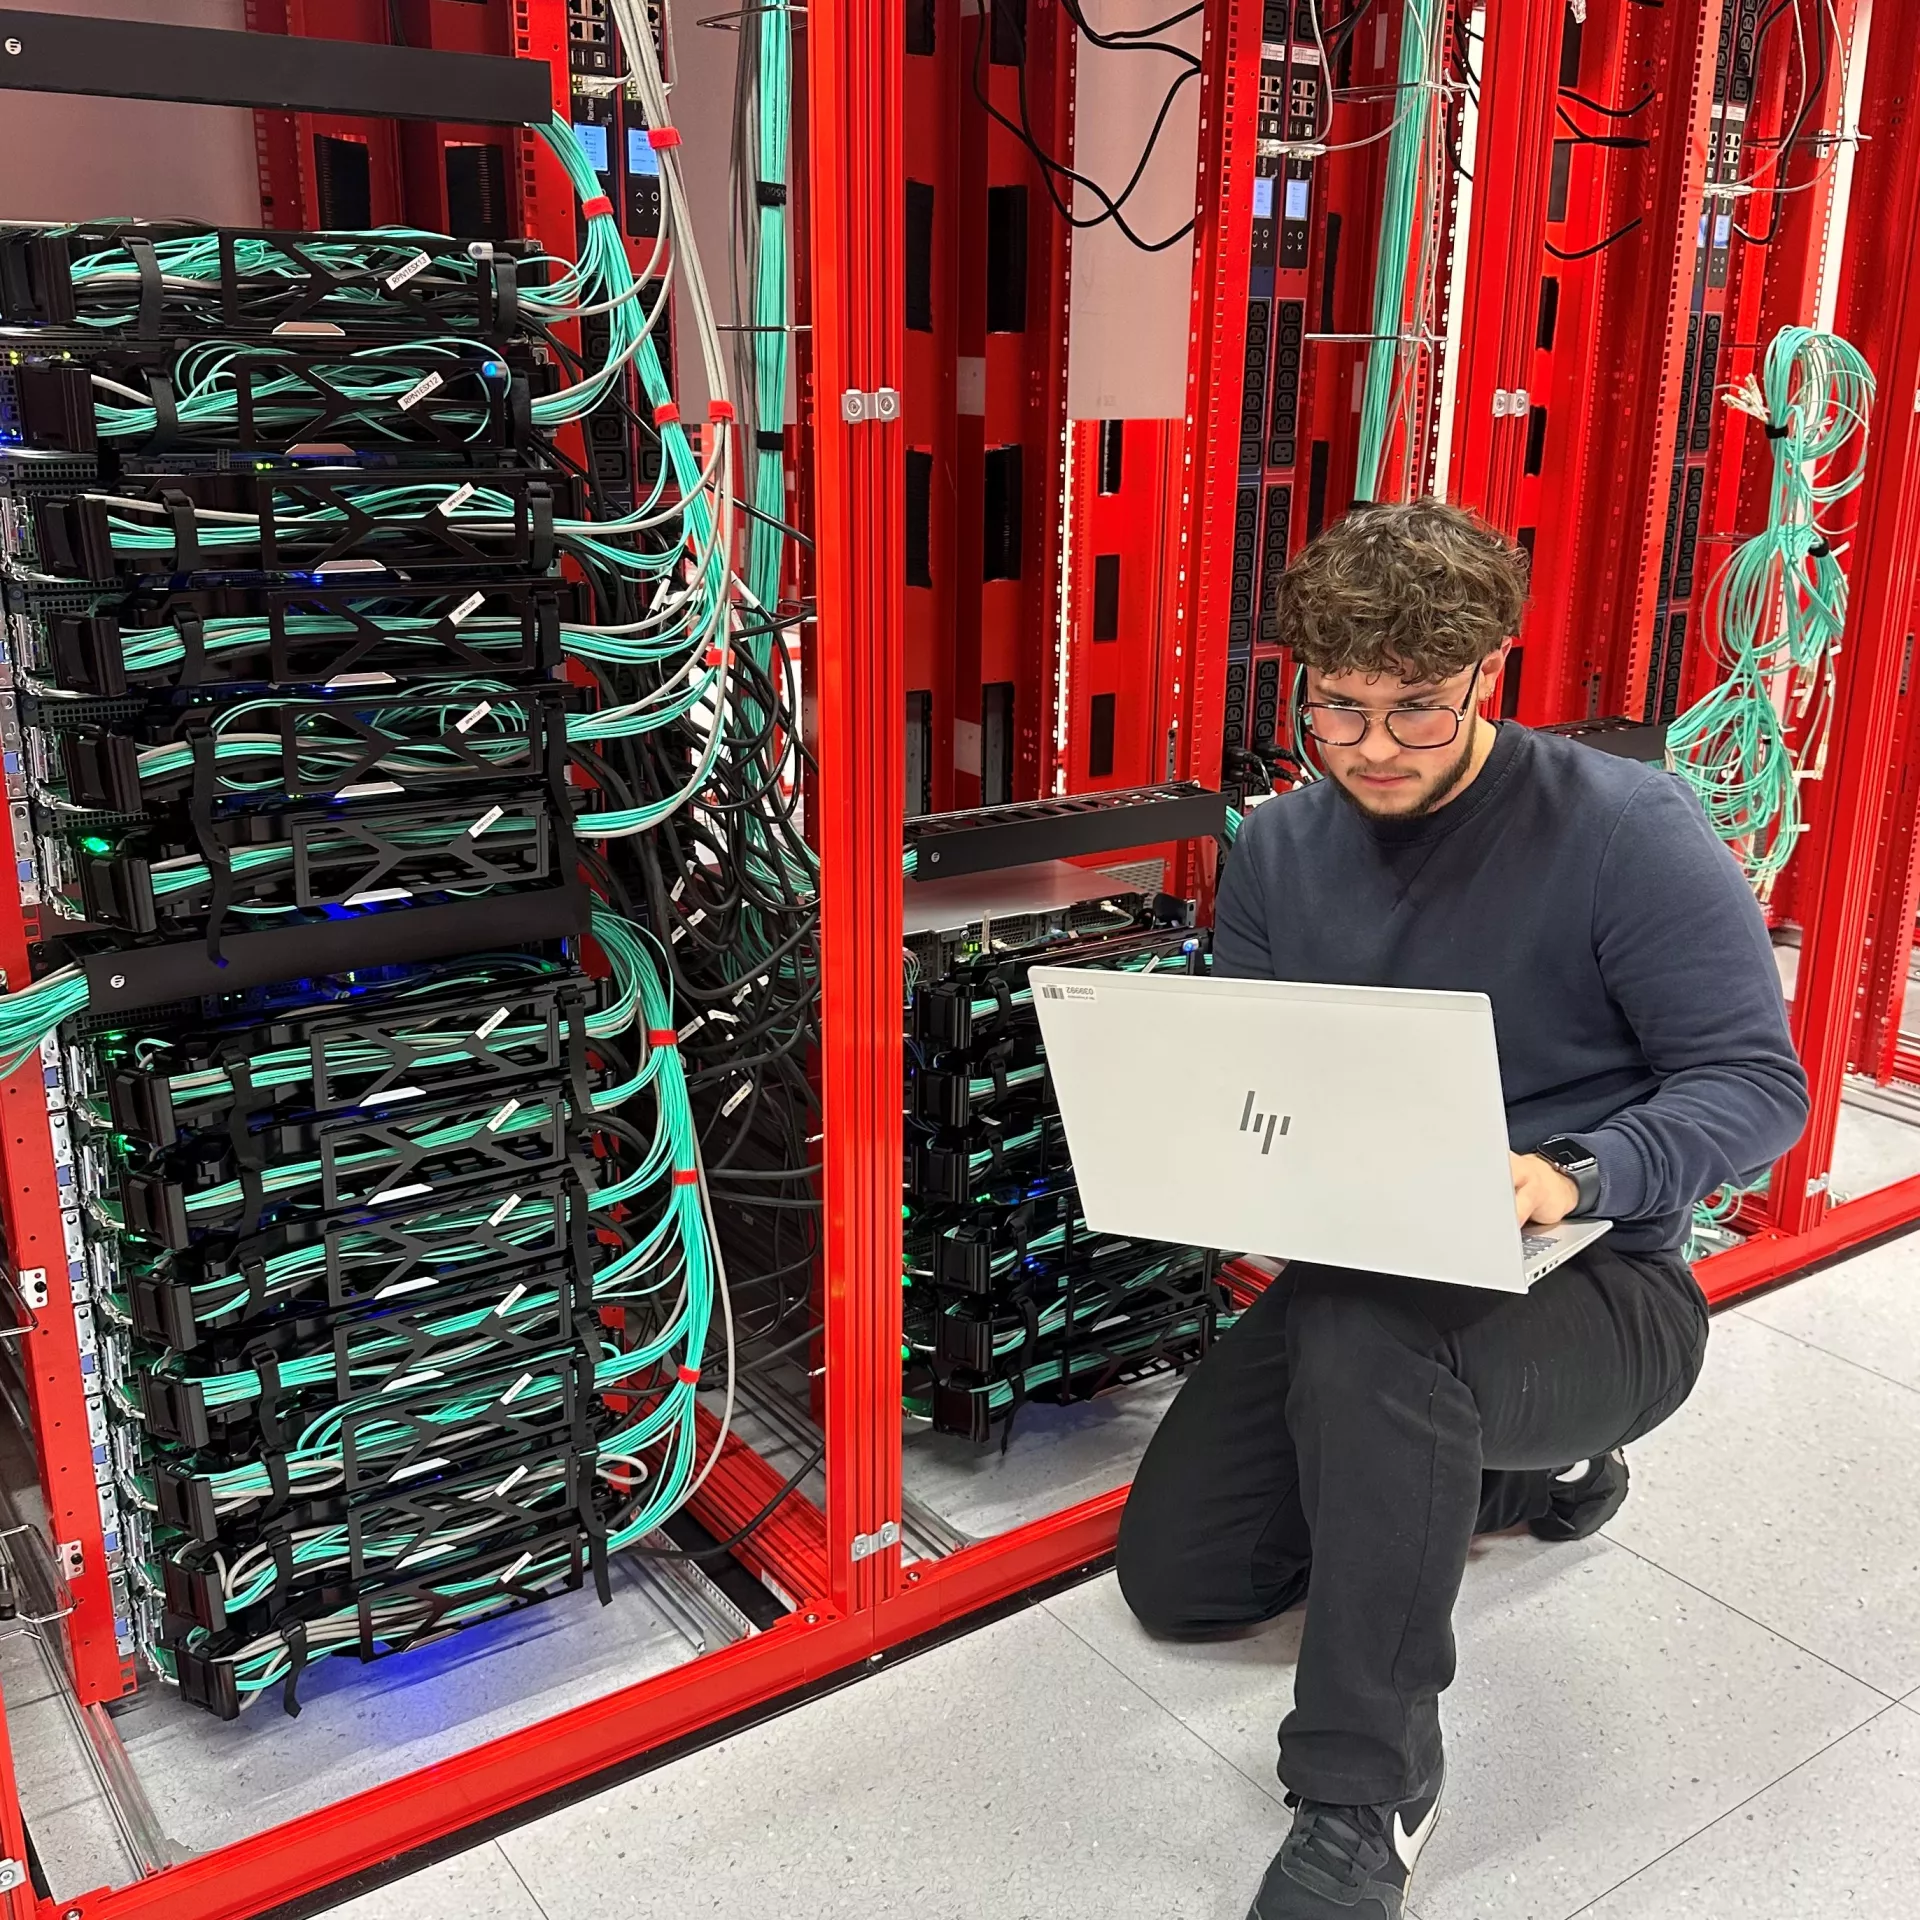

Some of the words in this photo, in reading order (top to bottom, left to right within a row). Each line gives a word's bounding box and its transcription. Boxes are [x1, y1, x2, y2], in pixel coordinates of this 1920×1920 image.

[391, 256, 427, 285] RPN1ESX13
[403, 376, 439, 405] RPN1ESX12
[1239, 1090, 1291, 1155] hp
